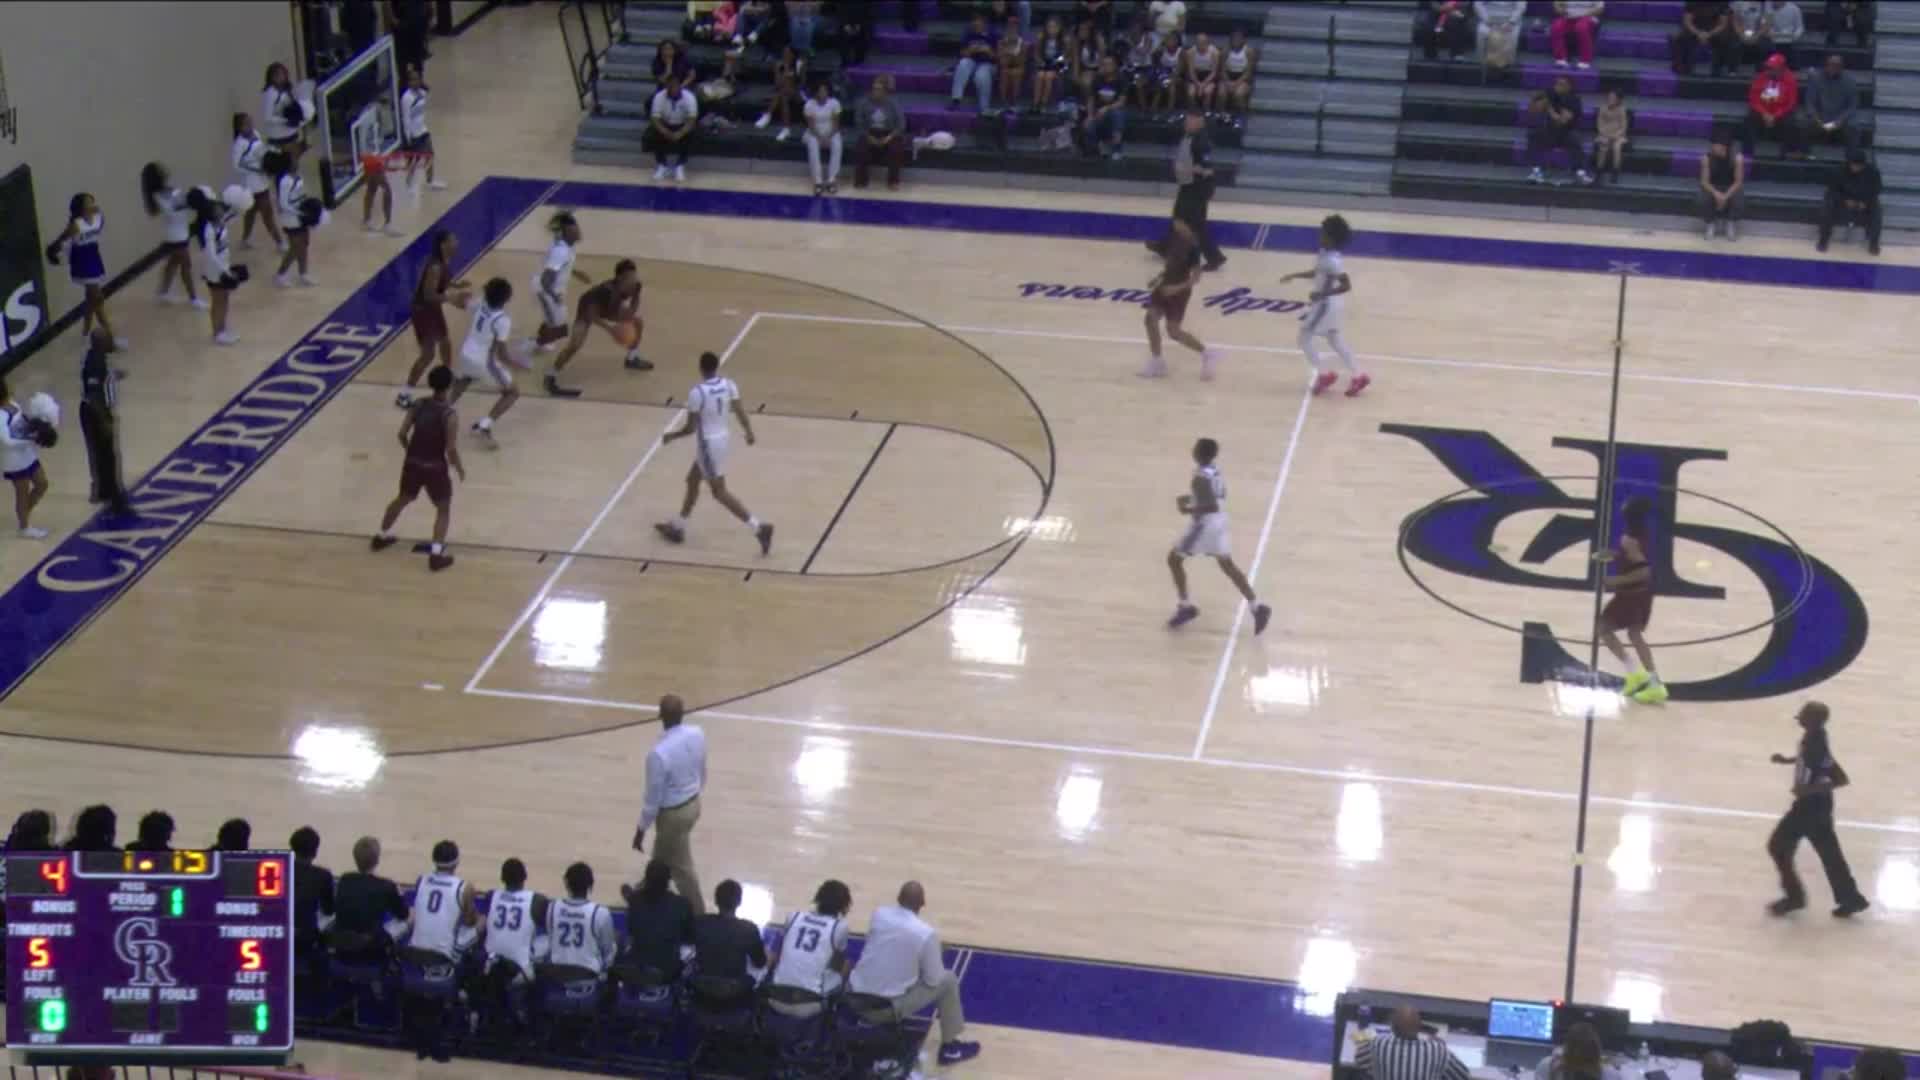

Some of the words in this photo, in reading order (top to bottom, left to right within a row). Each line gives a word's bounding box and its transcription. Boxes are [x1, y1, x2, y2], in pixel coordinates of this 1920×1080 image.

[1203, 287, 1309, 321] ady
[37, 458, 245, 592] CANE
[192, 322, 393, 453] RIDGE
[427, 890, 443, 913] 0
[494, 905, 523, 931] 33
[558, 922, 585, 947] 23
[795, 927, 821, 952] 13
